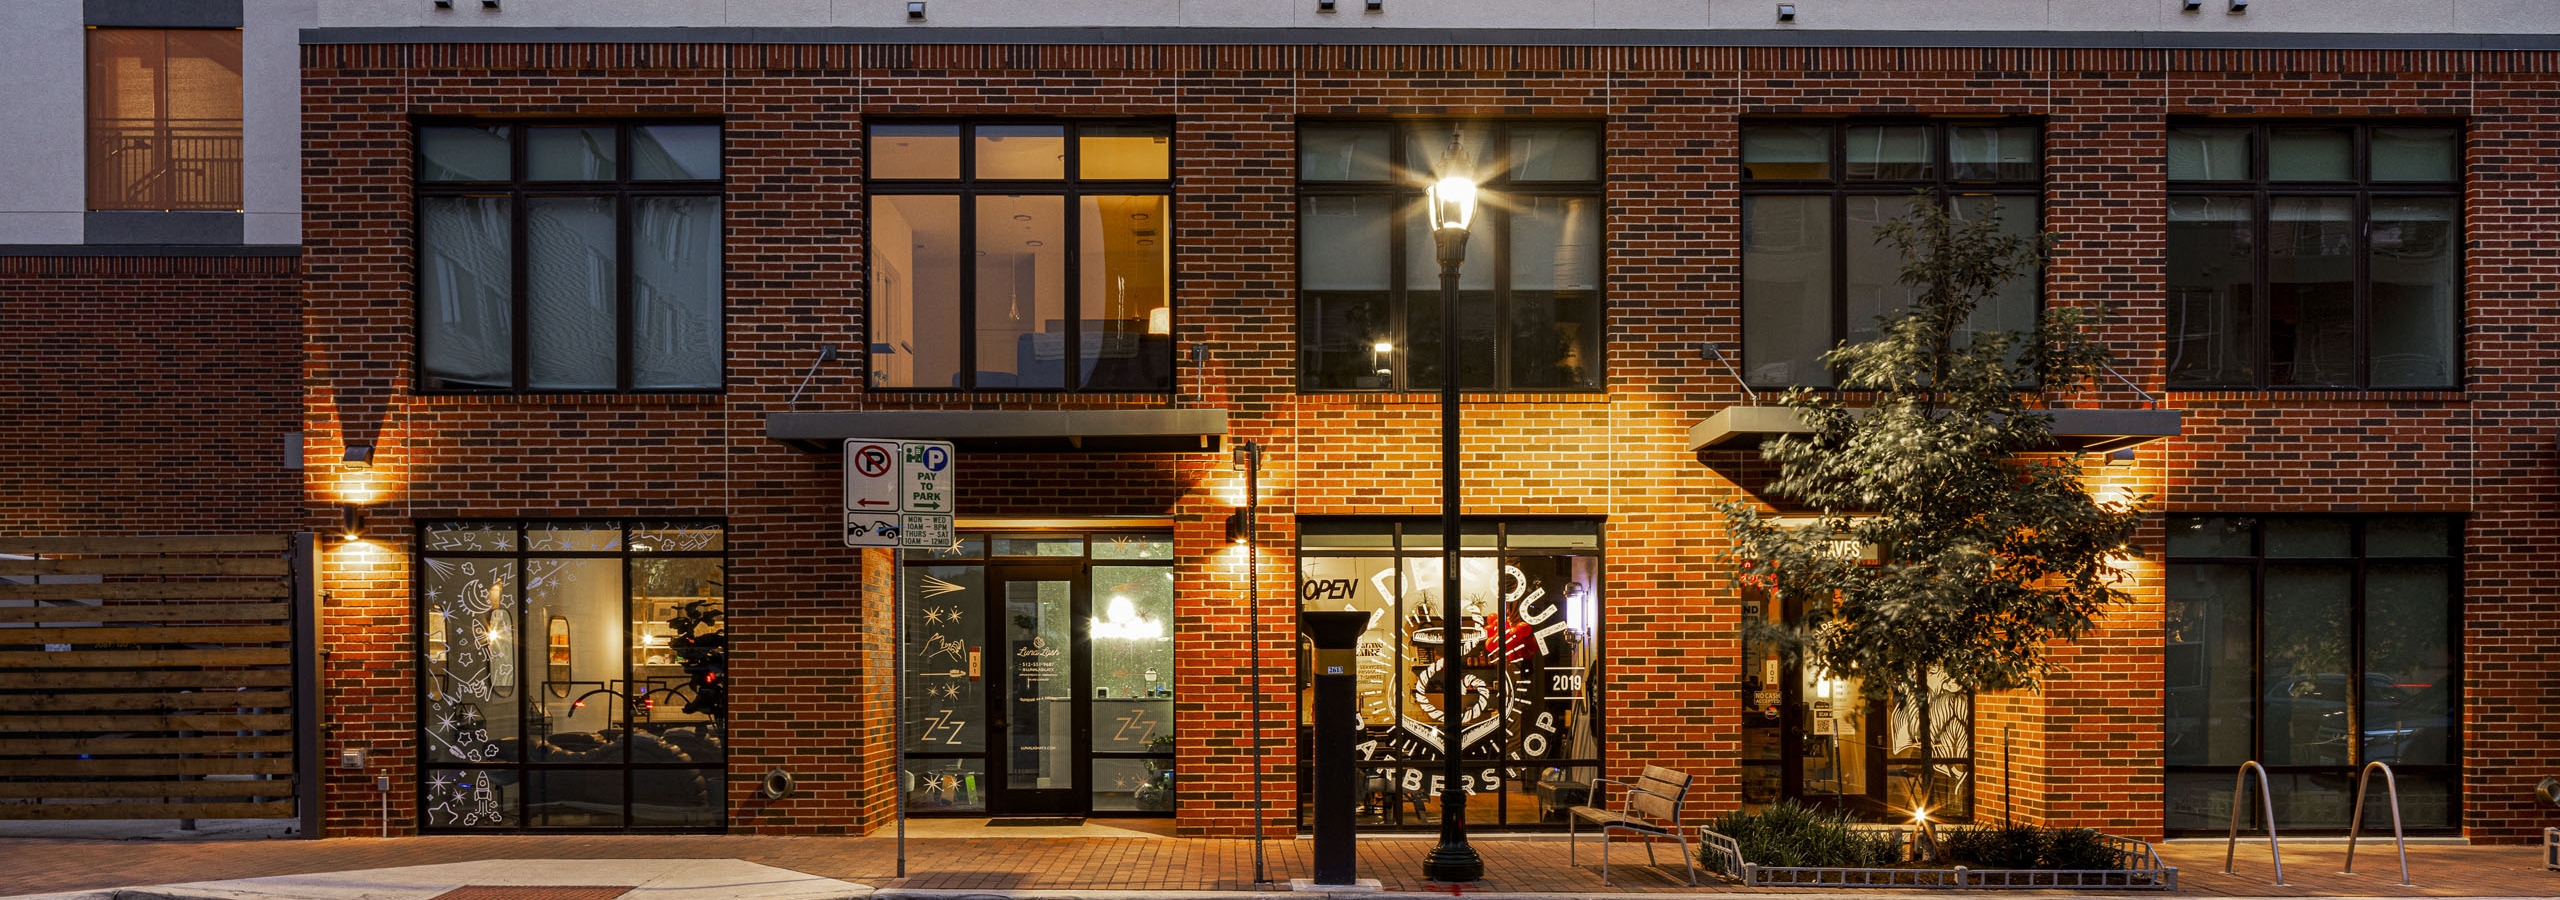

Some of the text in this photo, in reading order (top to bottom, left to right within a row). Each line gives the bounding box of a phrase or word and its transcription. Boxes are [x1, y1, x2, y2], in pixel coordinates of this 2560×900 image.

[917, 472, 937, 481] PAY
[920, 482, 933, 490] TO
[913, 492, 941, 500] PARK
[1743, 542, 1759, 559] TS
[1302, 578, 1358, 601] OPEN
[1017, 646, 1060, 658] Luna Lash
[1552, 674, 1582, 691] 2019
